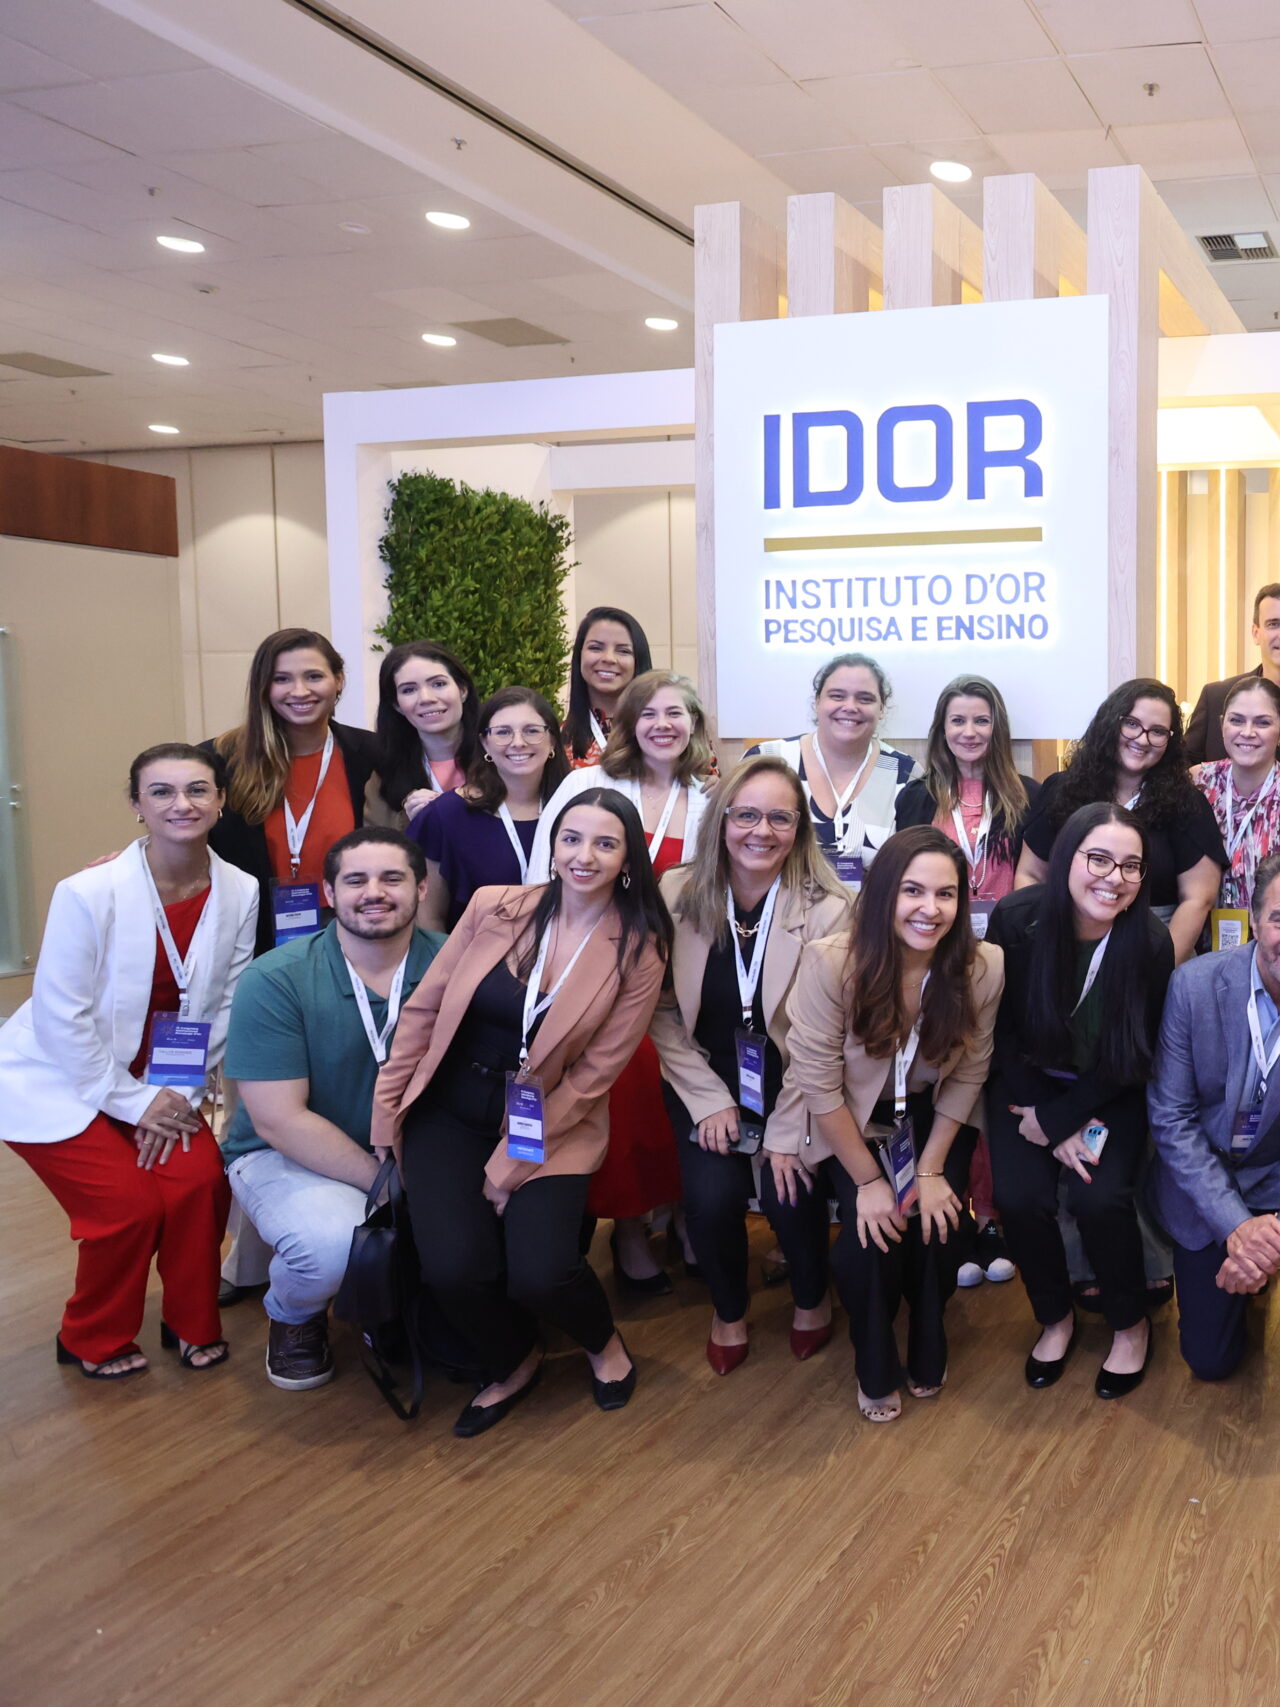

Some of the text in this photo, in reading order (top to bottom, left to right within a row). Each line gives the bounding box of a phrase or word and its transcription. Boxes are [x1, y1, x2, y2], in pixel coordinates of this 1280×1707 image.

[763, 398, 1043, 510] IDOR
[764, 571, 1046, 610] INSTITUTO D'OR
[764, 613, 1049, 646] PESQUISA E ENSINO
